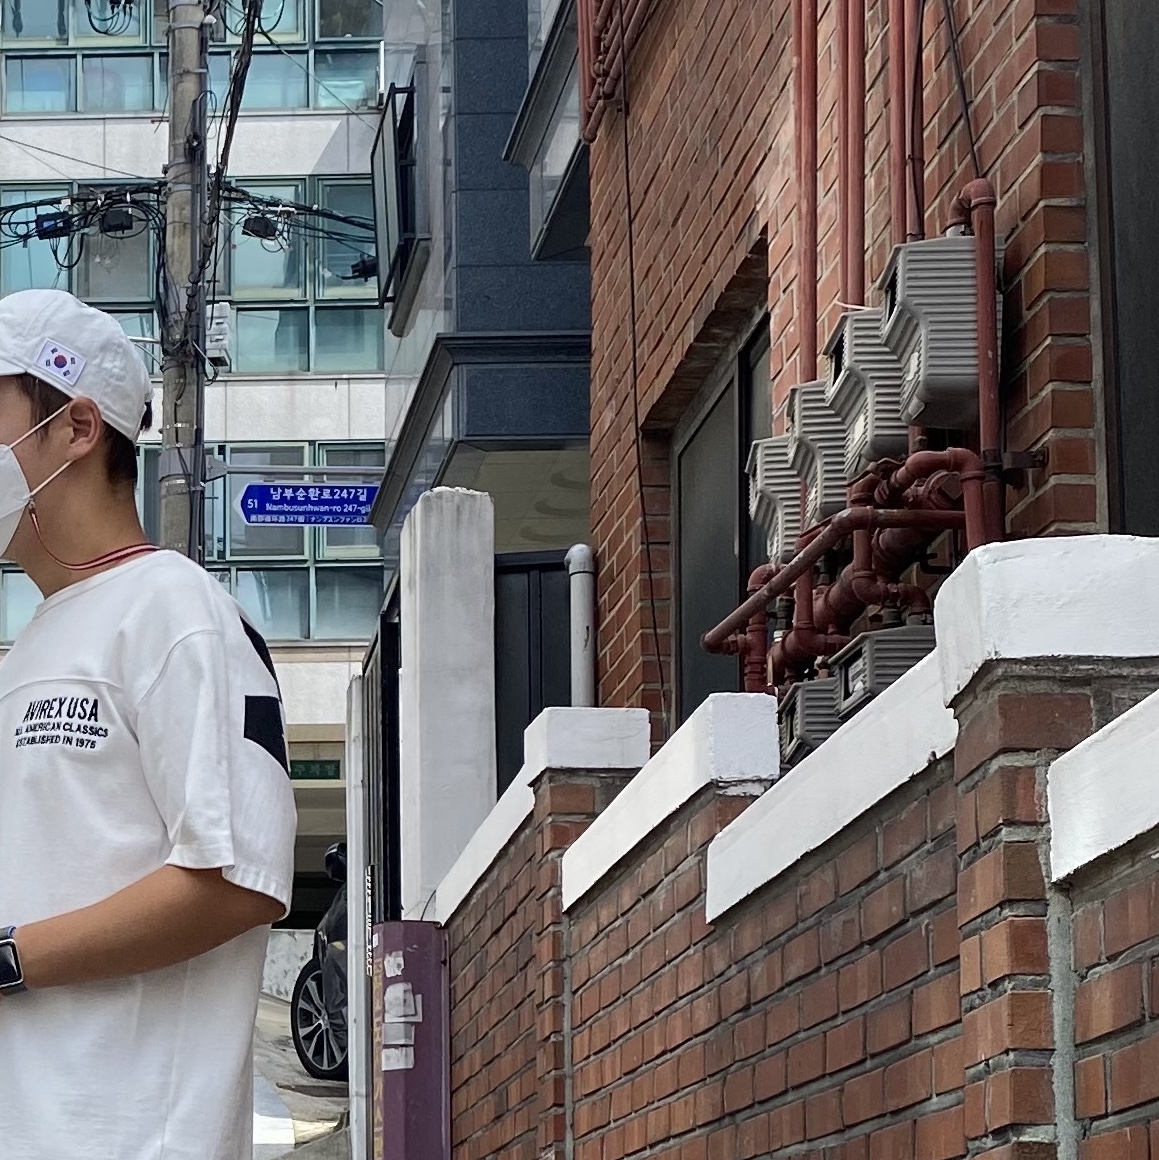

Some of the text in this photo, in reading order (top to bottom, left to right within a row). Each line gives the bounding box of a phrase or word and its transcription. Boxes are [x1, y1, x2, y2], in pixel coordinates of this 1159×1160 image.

[270, 487, 368, 502] 남부순환로247길
[247, 498, 258, 509] 51
[265, 502, 342, 512] Nambusunhwan-ro
[22, 696, 99, 723] AVIREX USA
[24, 721, 62, 733] AMERICAN
[62, 722, 109, 738] CLASSICS
[16, 735, 97, 749] ESTABLISHED IN 1975
